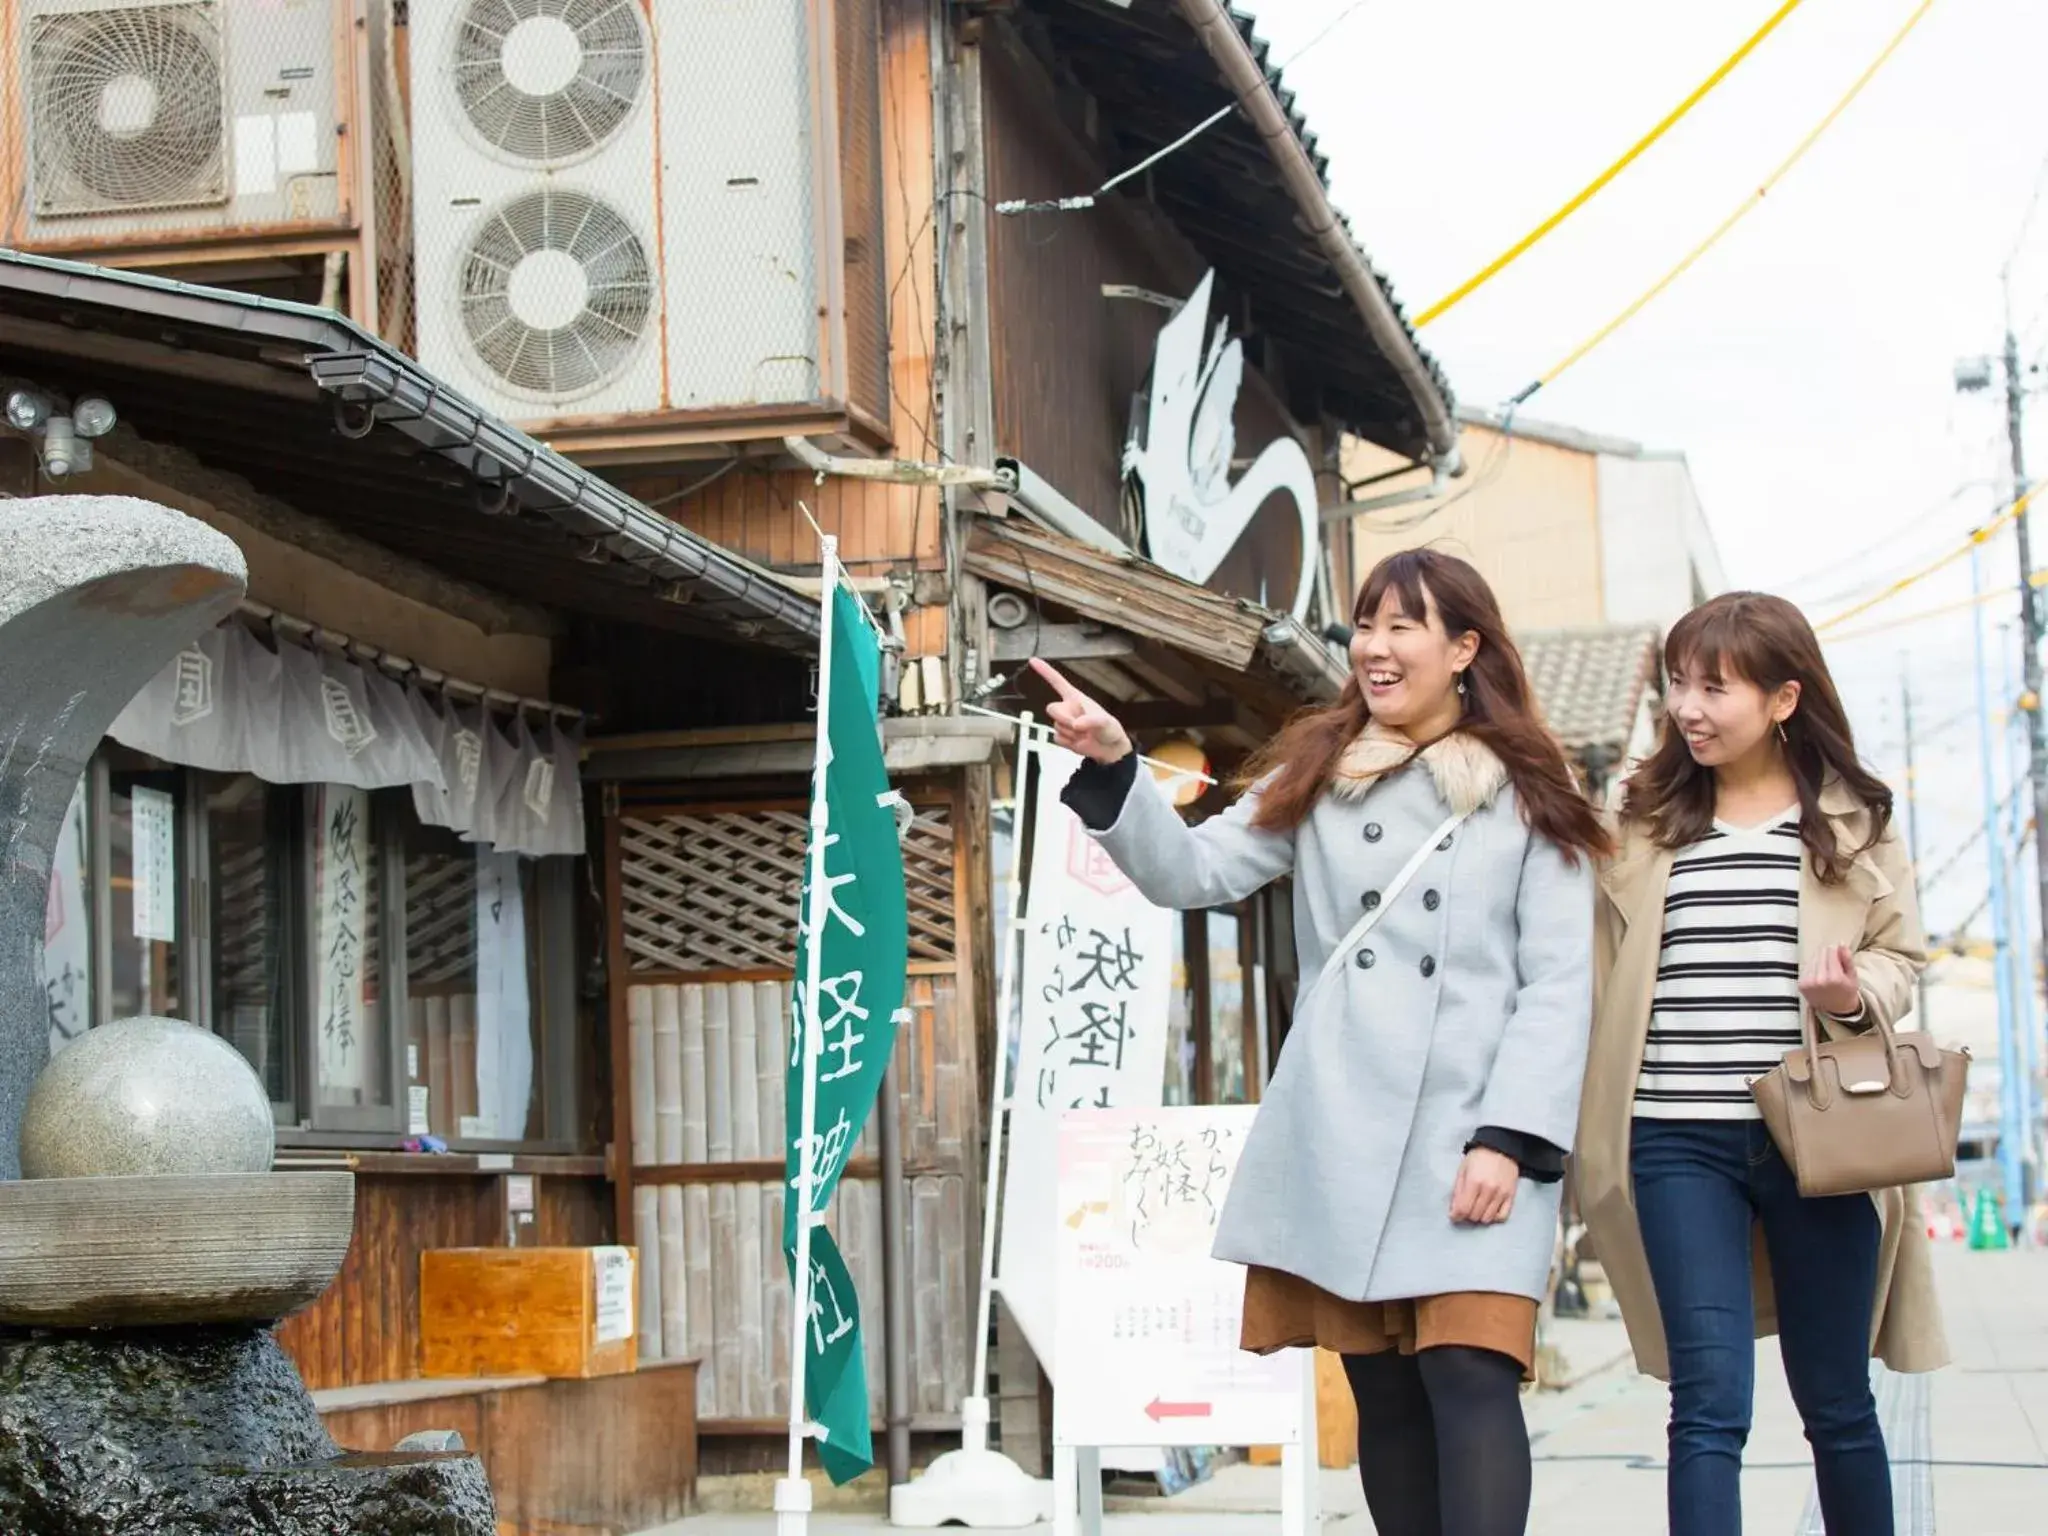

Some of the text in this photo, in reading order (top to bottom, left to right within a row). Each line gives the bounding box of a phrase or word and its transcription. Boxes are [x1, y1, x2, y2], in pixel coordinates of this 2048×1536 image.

[1123, 1122, 1158, 1250] おみくじ
[1154, 1139, 1197, 1207] 妖怪
[1199, 1128, 1232, 1226] からくり
